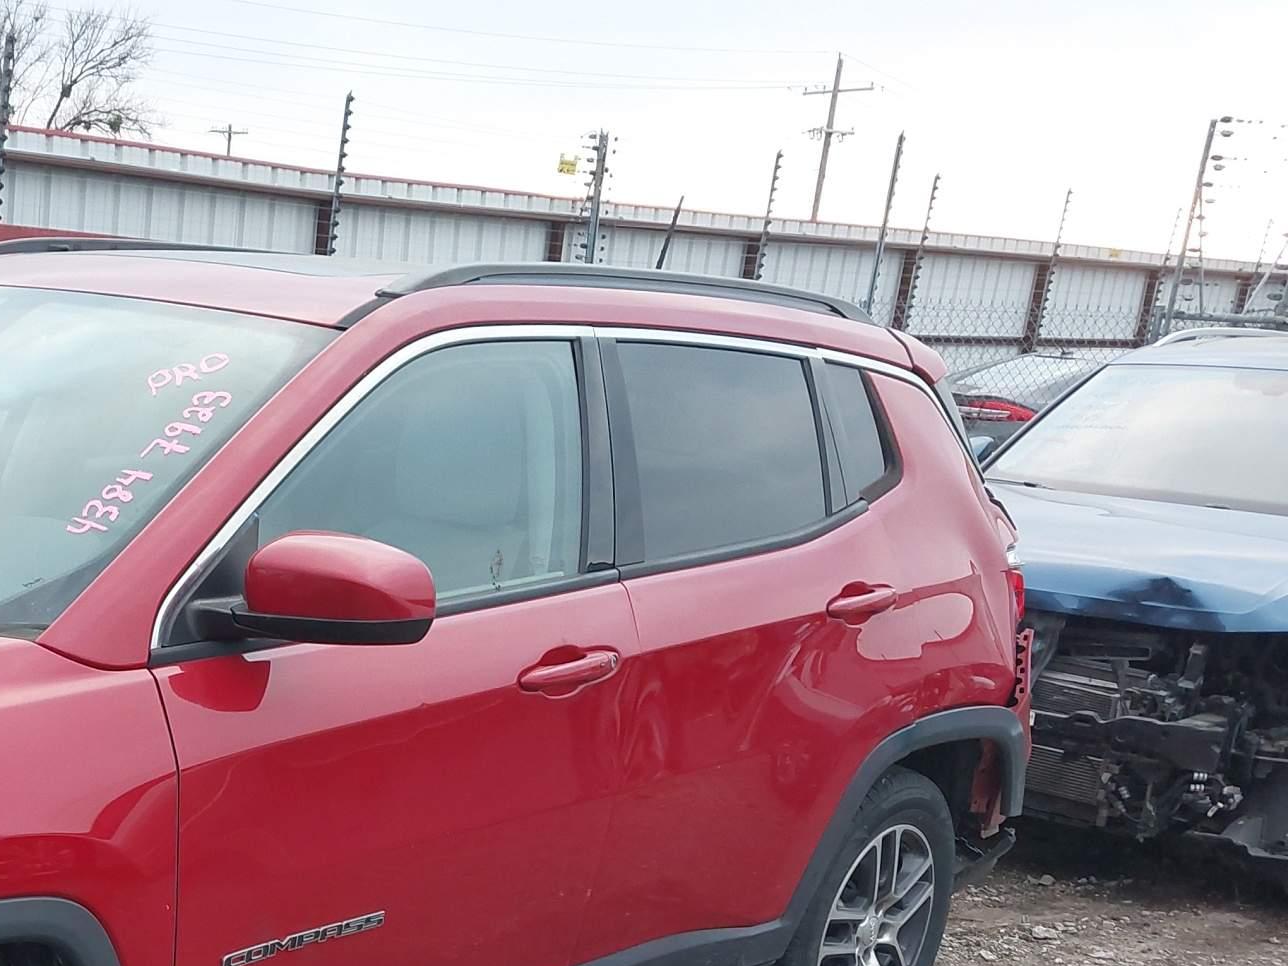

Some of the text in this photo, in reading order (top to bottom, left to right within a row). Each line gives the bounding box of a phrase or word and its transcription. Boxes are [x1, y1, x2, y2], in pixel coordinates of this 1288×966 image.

[147, 352, 231, 397] PRO
[65, 391, 233, 534] 4384 7923
